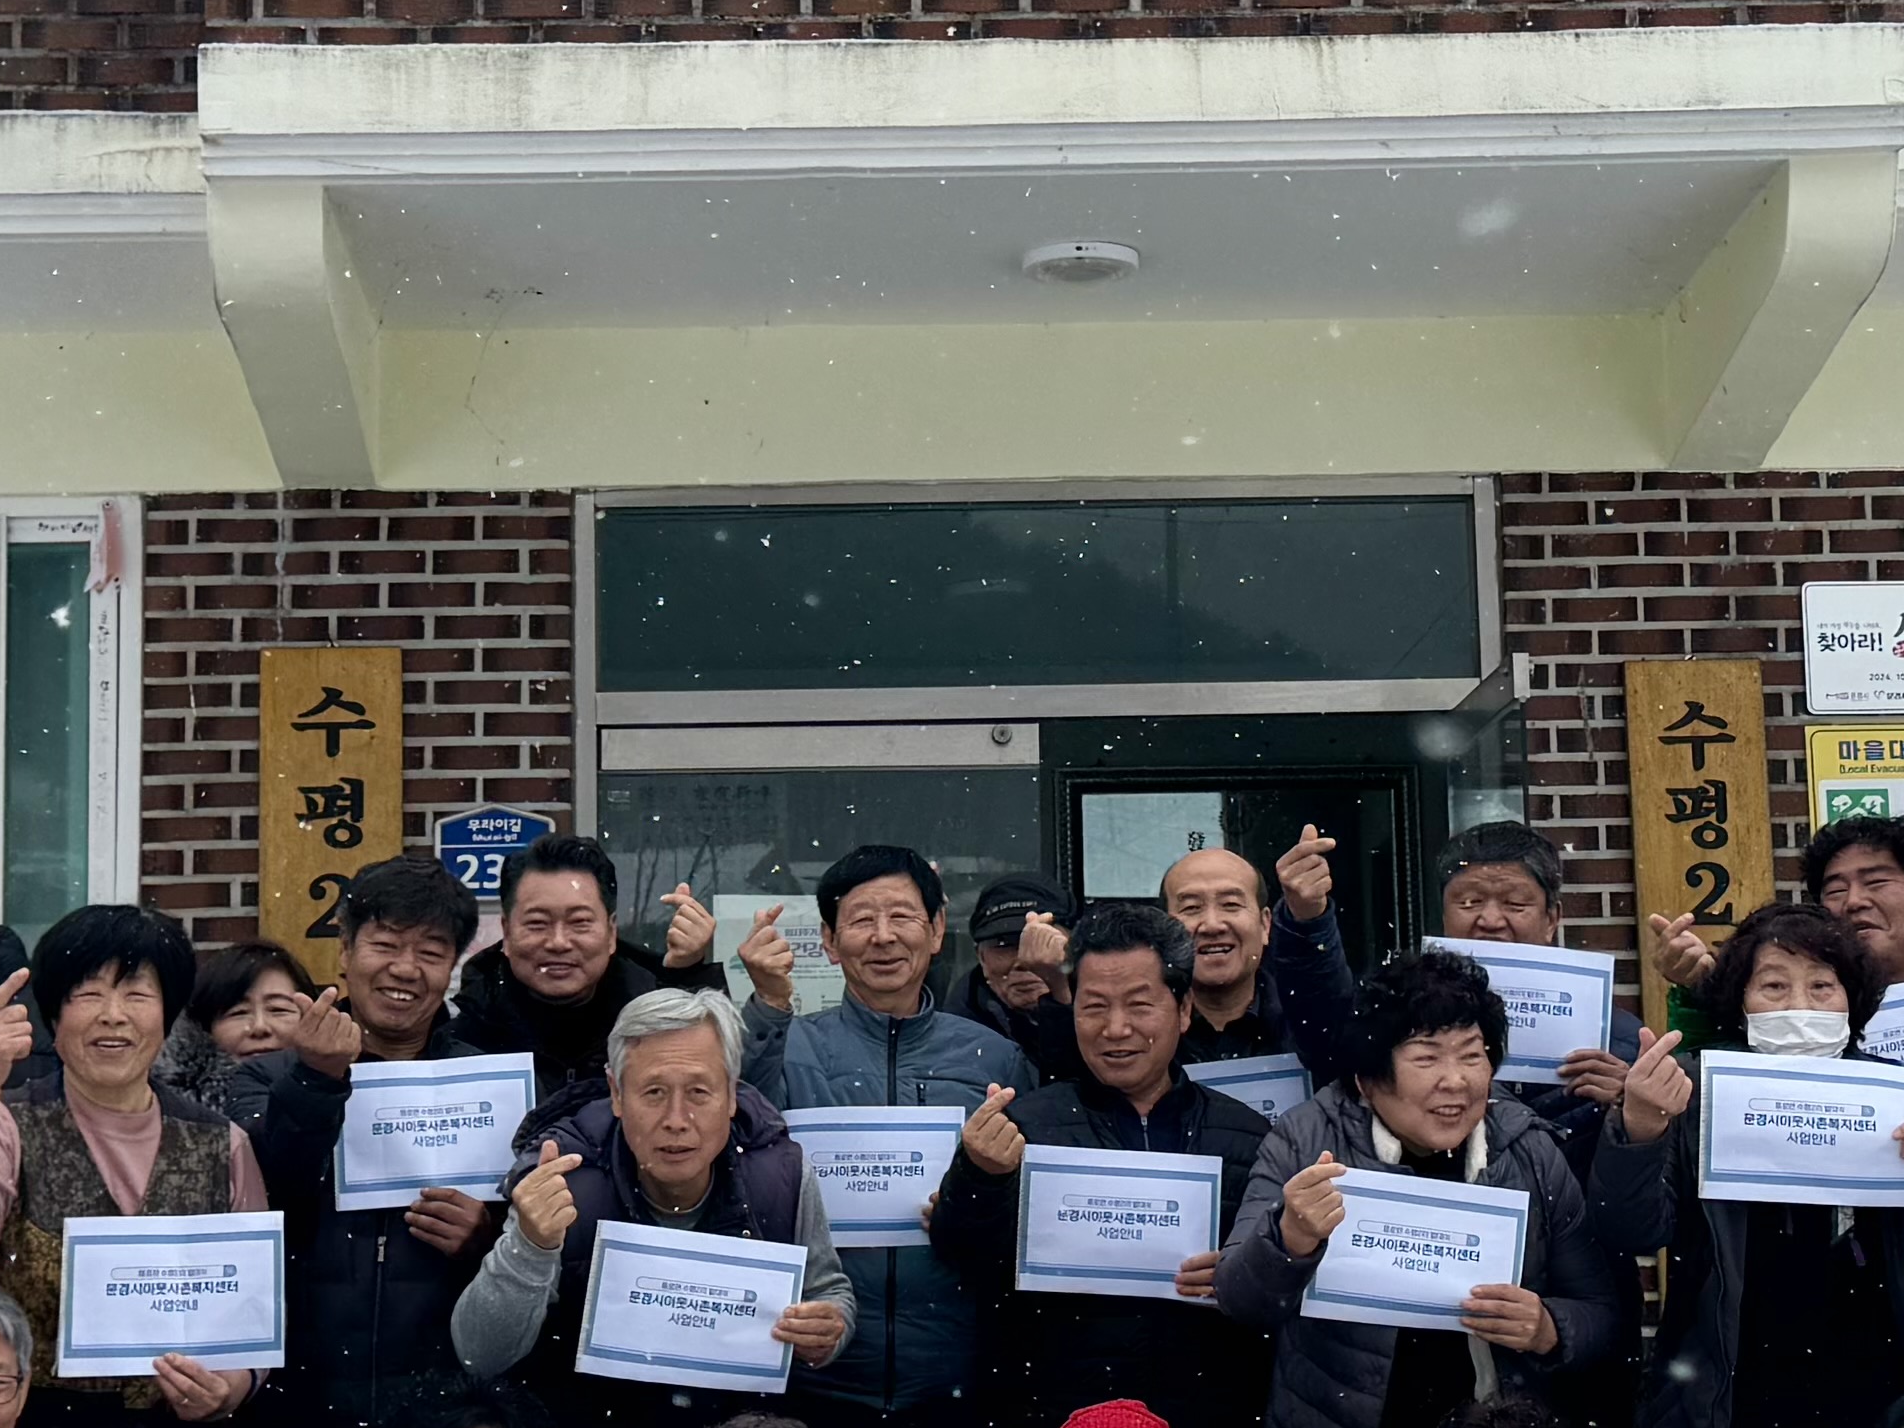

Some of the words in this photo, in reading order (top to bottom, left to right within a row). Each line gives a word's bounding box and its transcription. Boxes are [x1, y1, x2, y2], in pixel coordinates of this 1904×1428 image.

[1817, 633, 1883, 652] 찾아라!
[1658, 700, 1736, 948] 수평2
[456, 854, 505, 889] 23
